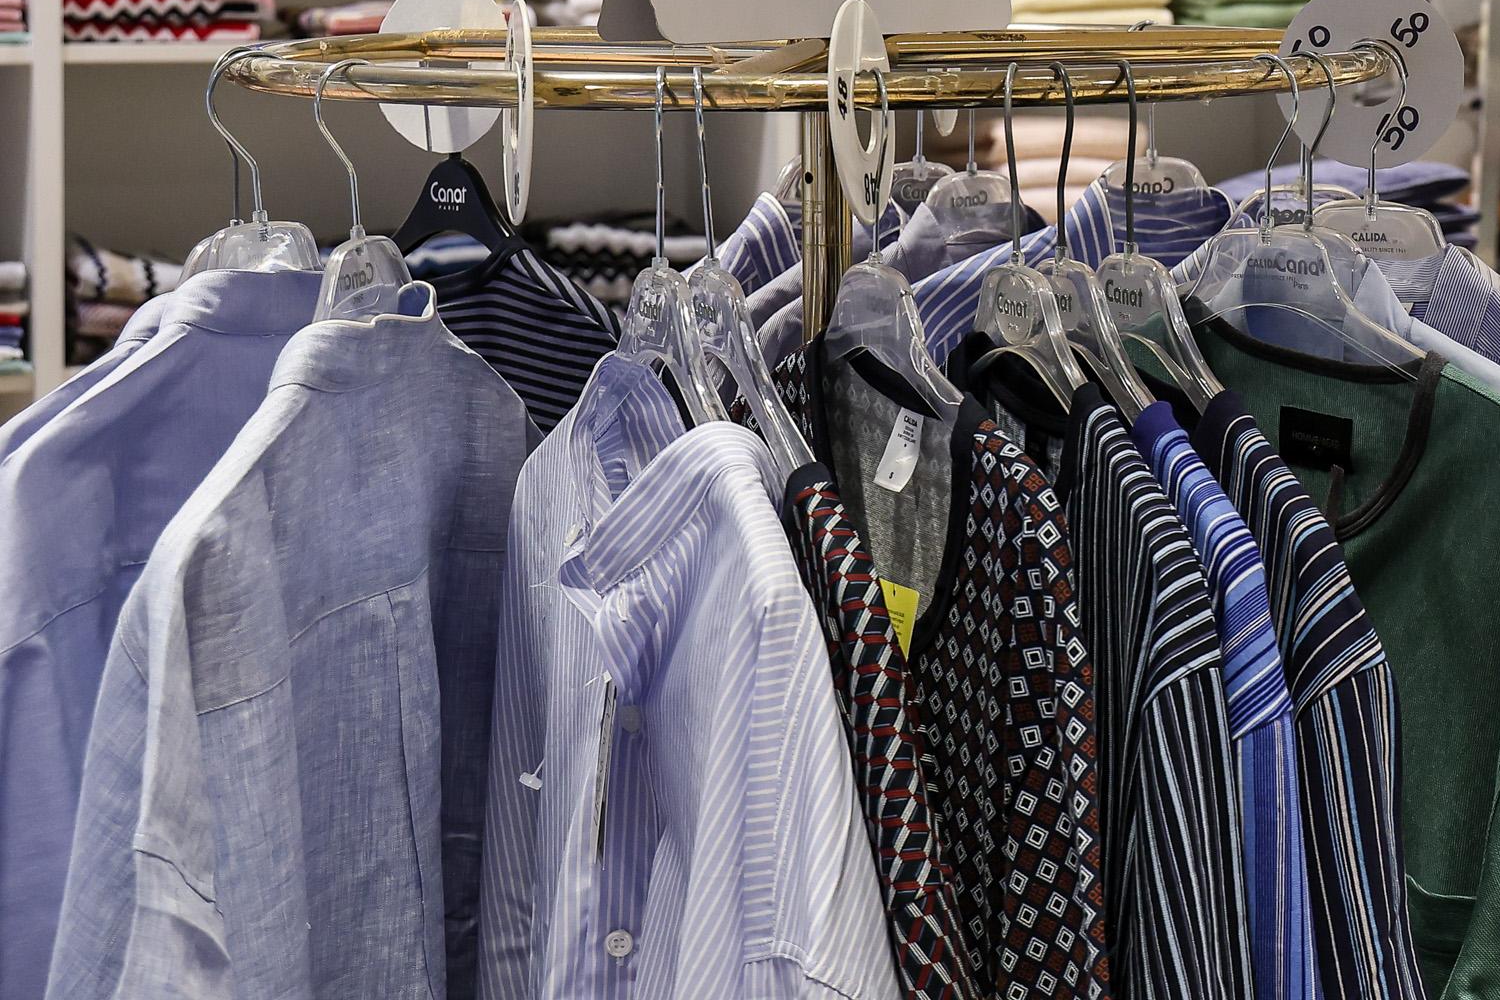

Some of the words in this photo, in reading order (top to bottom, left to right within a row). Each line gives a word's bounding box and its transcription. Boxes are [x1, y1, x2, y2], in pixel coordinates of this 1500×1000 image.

[1291, 25, 1331, 53] 0
[1376, 105, 1420, 150] 50
[430, 181, 467, 204] Canat
[901, 183, 929, 201] Can
[1351, 232, 1387, 243] CALIDA
[1247, 257, 1278, 269] CALIDA
[996, 291, 1028, 319] Canat
[1105, 278, 1143, 308] Canat
